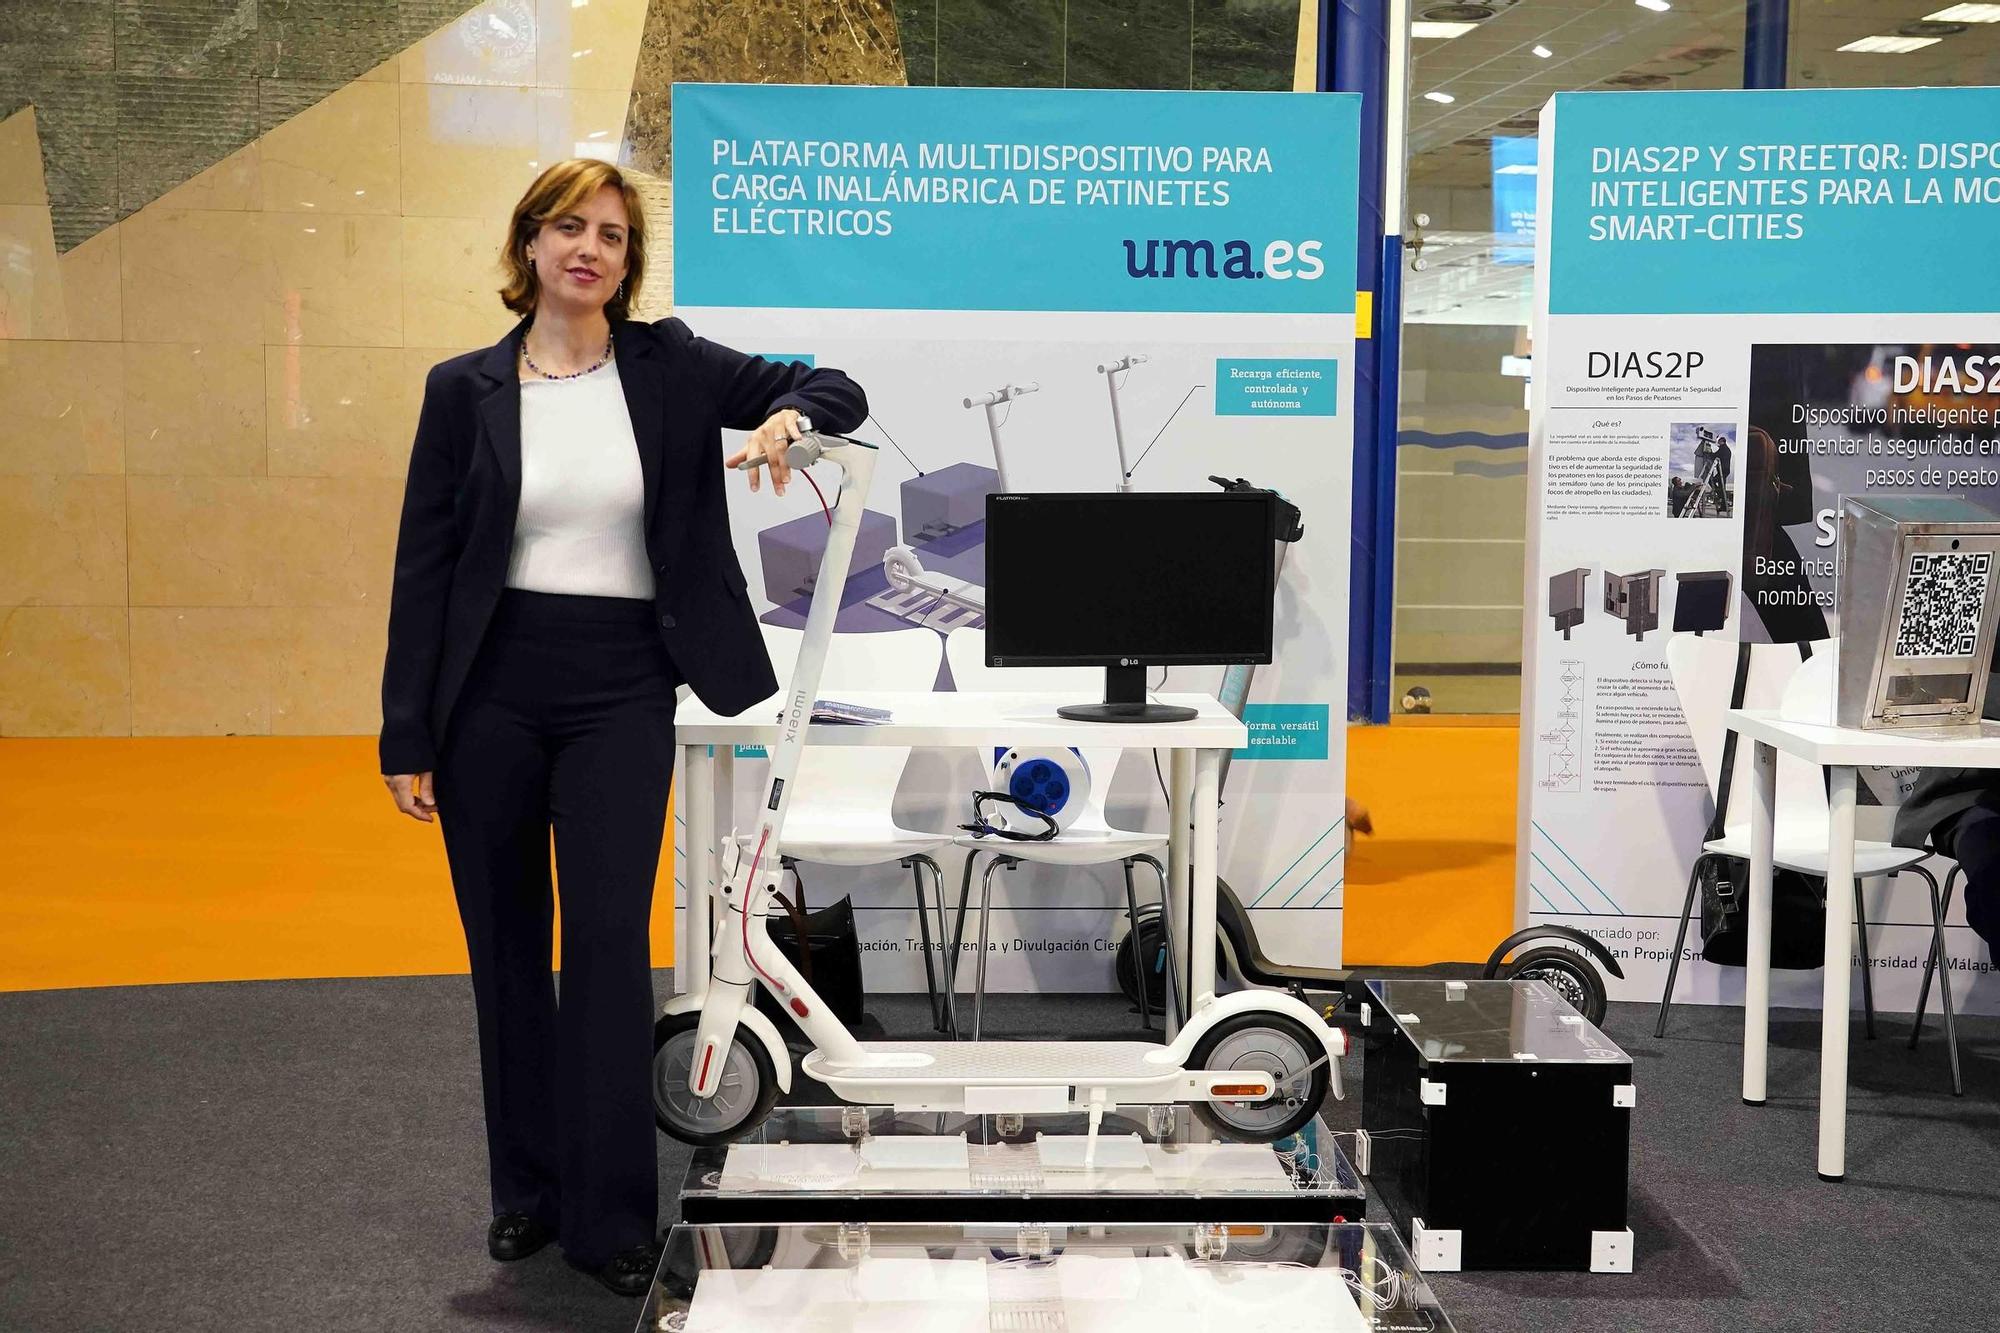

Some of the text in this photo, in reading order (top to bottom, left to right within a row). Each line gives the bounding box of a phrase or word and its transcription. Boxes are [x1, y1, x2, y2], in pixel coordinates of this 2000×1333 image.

[712, 139, 1272, 173] PLATAFORMA MULTIDISPOSITIVO PARA
[1592, 146, 1699, 173] DIAS2P
[1708, 146, 1729, 172] Y
[1738, 143, 1907, 173] STREETQR:
[711, 171, 1230, 207] CARGA INALÁMBRICA DE PATINETES
[1591, 179, 1808, 207] INTELIGENTES
[1819, 178, 1893, 205] PARA
[1904, 177, 1943, 204] LA
[712, 205, 892, 237] ELÉCTRICOS
[1589, 213, 1804, 241] SMART-CITIES
[1123, 238, 1324, 280] uma.es
[1230, 368, 1322, 380] Recarga eficiente,
[1588, 352, 1704, 378] DIAS2P
[1245, 384, 1308, 395] controlada y
[1251, 399, 1300, 408] autónoma
[1792, 404, 1887, 428] Dispositivo
[1892, 404, 1988, 429] inteligente
[1778, 433, 2000, 459] aumentar la seguridad en
[1866, 468, 1915, 488] pasos
[1920, 464, 1942, 485] de
[1755, 557, 1795, 576] Base
[1758, 585, 1834, 606] nombres
[1632, 662, 1658, 670] ¿Cómo
[785, 690, 807, 743] xiaomi
[1246, 721, 1319, 730] forma versátil
[1251, 736, 1296, 745] escalable
[858, 940, 900, 953] gación,
[1002, 943, 1008, 953] y
[1014, 939, 1089, 953] Divulgación
[1637, 930, 1660, 941] por:
